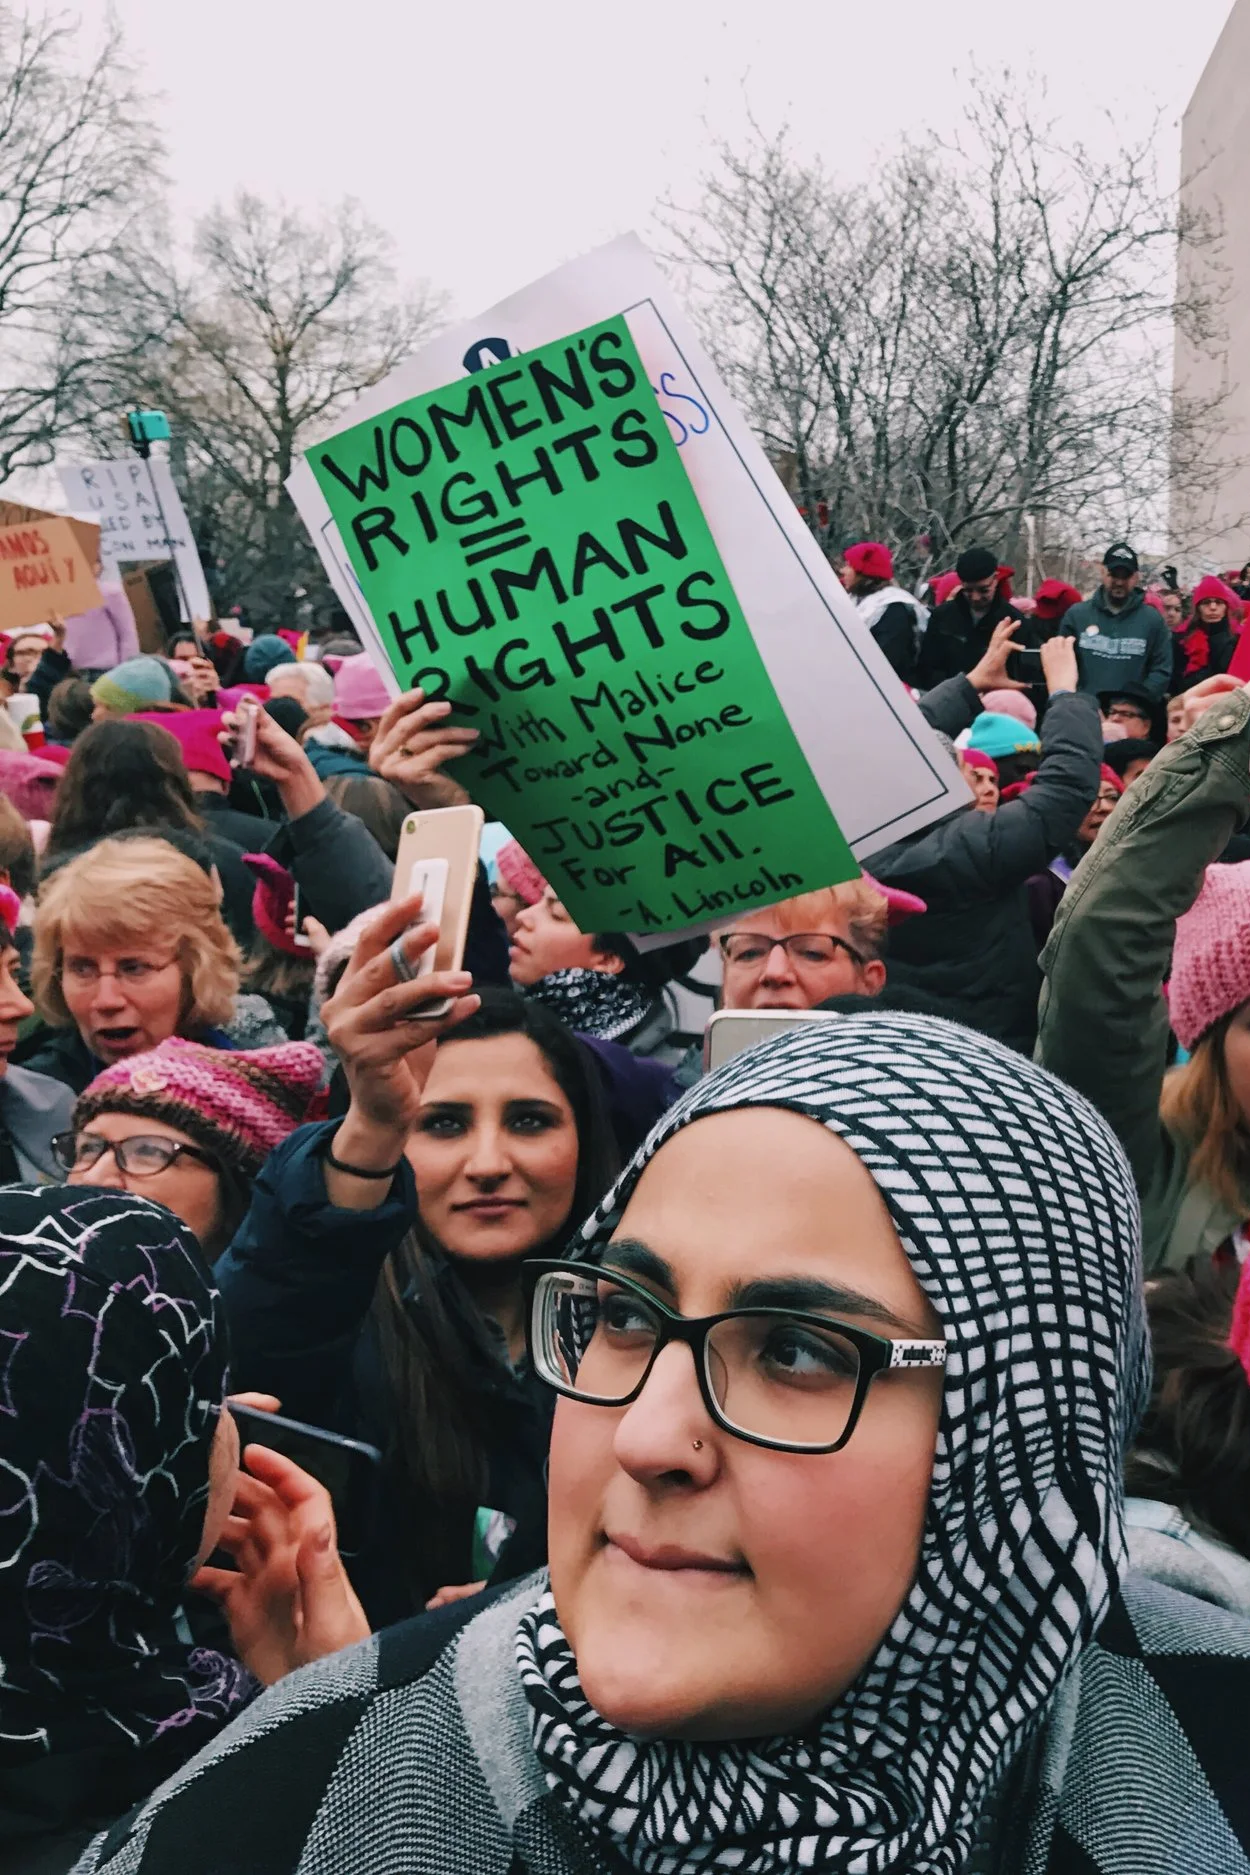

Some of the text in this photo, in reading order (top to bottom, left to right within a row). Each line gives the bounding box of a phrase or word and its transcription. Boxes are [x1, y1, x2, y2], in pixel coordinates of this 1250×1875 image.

[320, 331, 637, 502] WOMEN'S
[88, 491, 151, 512] USA
[350, 409, 659, 571] RIGHTS
[388, 500, 690, 665] HUMAN
[409, 570, 731, 718] RIGHTS
[471, 658, 725, 761] With Malice
[481, 702, 753, 793] Toward None
[532, 762, 796, 855] JUSTICE
[559, 857, 636, 893] For
[681, 868, 805, 921] Lincoln
